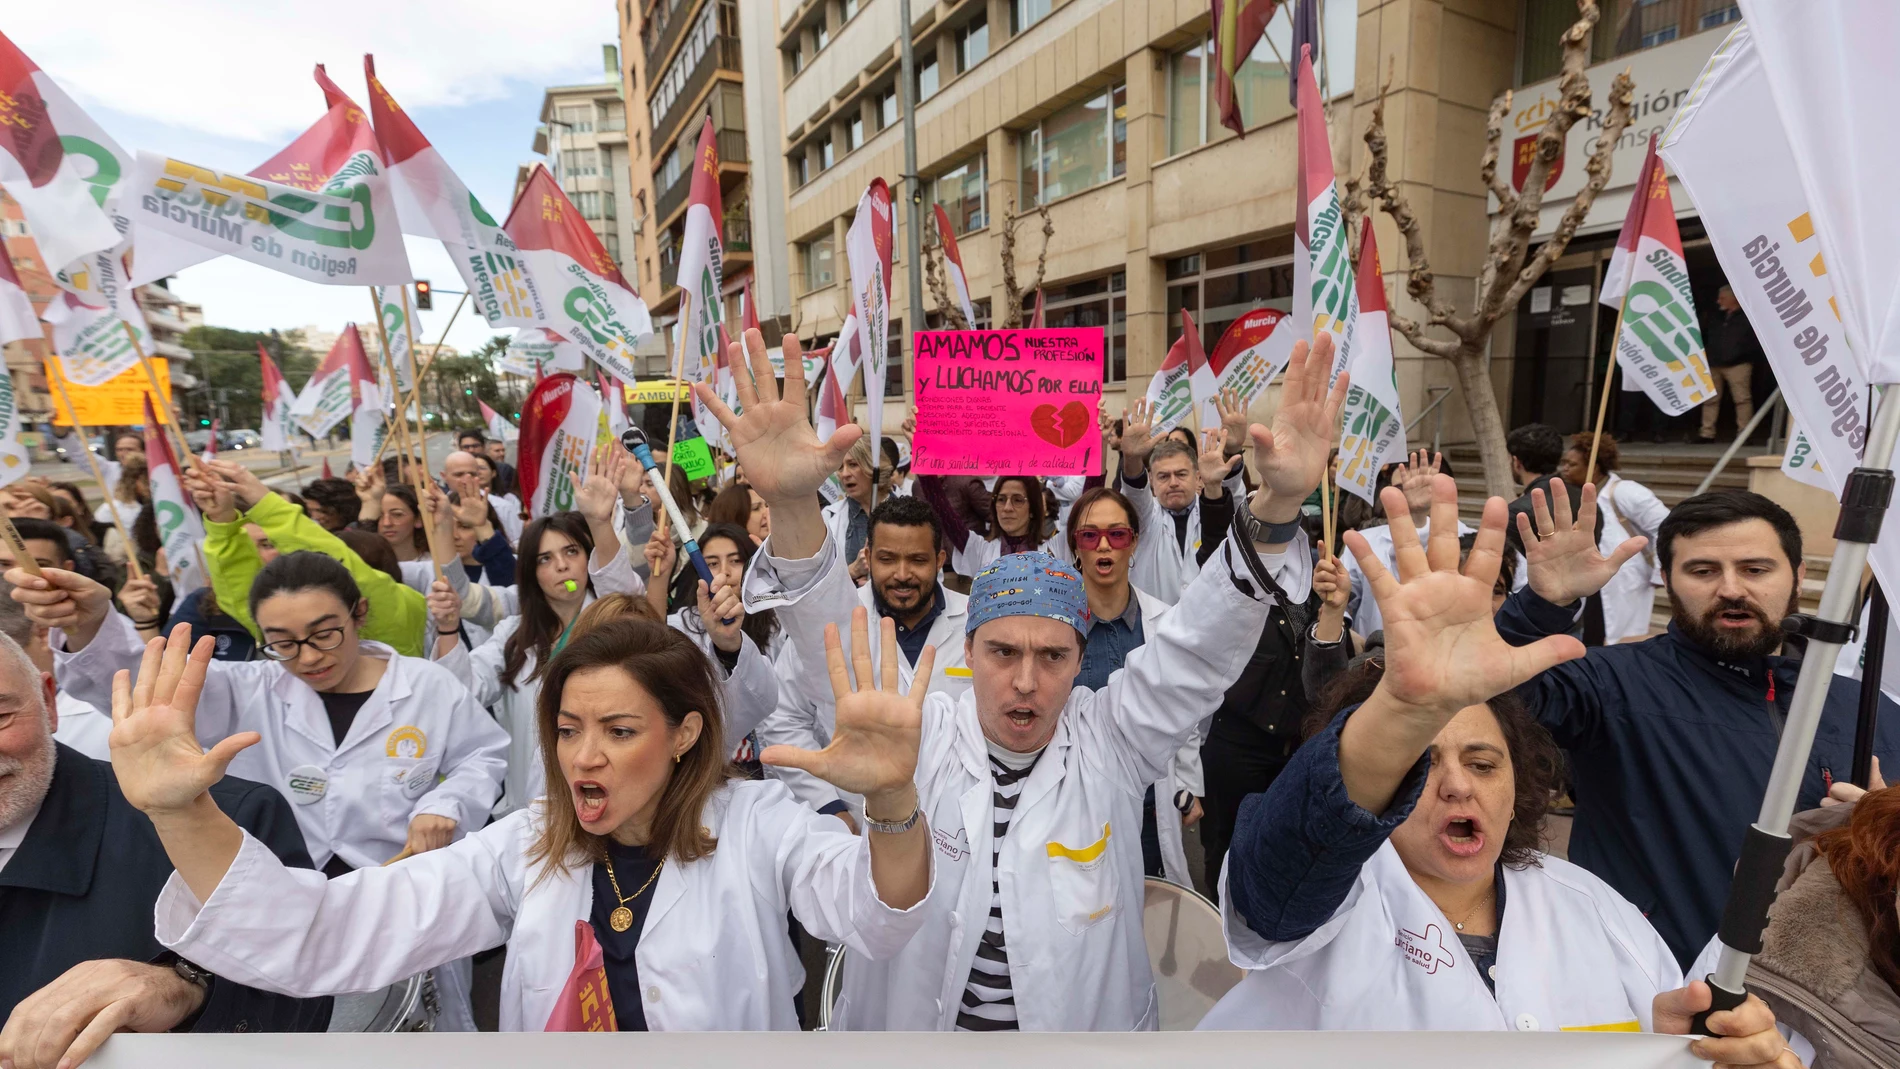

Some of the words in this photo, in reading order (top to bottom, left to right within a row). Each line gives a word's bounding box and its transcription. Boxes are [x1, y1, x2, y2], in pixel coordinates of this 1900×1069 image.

[1244, 315, 1277, 330] Murcia
[917, 333, 1020, 361] AMAMOS
[1025, 337, 1078, 348] NUESTRA
[1034, 347, 1095, 361] PROFESIÓN
[595, 349, 606, 360] de
[606, 356, 635, 380] Murcia
[1234, 349, 1255, 374] Médico
[1639, 364, 1659, 379] de
[936, 366, 1036, 395] LUCHAMOS
[1038, 377, 1062, 393] POR
[1069, 379, 1100, 395] ELLA
[1262, 365, 1277, 383] Murcia
[541, 381, 571, 406] Murcia
[966, 396, 992, 404] DIGNAS
[542, 467, 558, 515] Sindicato
[551, 429, 565, 466] Médico
[913, 446, 928, 468] Por
[930, 458, 945, 469] una
[948, 454, 979, 470] sanidad
[985, 459, 1011, 474] segura
[1018, 459, 1023, 474] y
[1029, 455, 1038, 469] de
[1042, 454, 1076, 469] calidad
[1049, 587, 1068, 595] RALLY
[996, 599, 1033, 609] GO-GO-GO!
[1395, 937, 1432, 961] urciano
